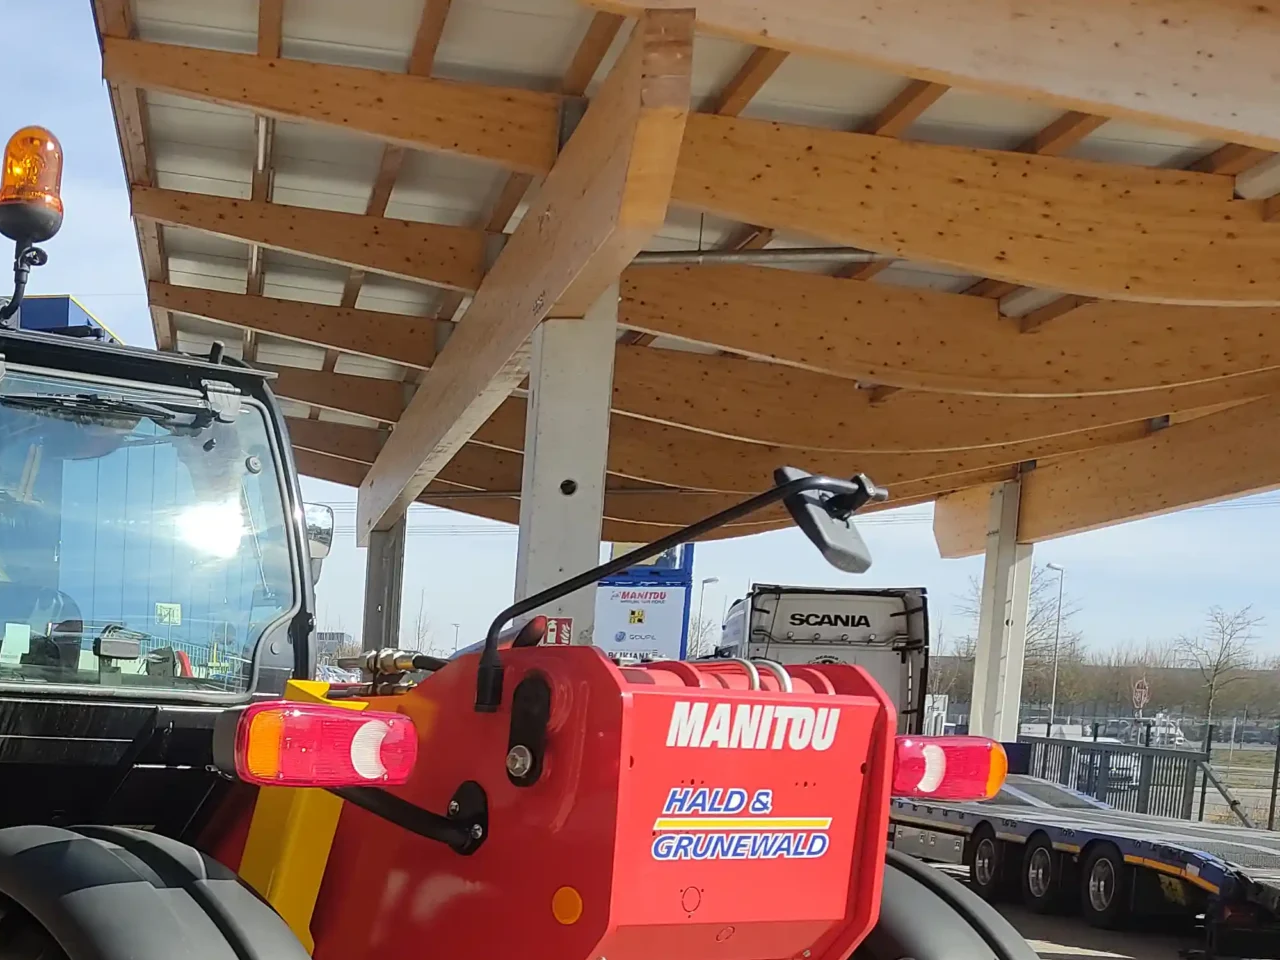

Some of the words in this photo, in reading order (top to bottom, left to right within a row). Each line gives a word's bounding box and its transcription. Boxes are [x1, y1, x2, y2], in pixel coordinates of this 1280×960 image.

[621, 591, 667, 600] MANITOU
[789, 613, 871, 628] SCANIA
[665, 700, 841, 751] MANITOU
[662, 786, 746, 816] HALD
[750, 789, 773, 815] &
[651, 832, 829, 861] GRUNEWALD
